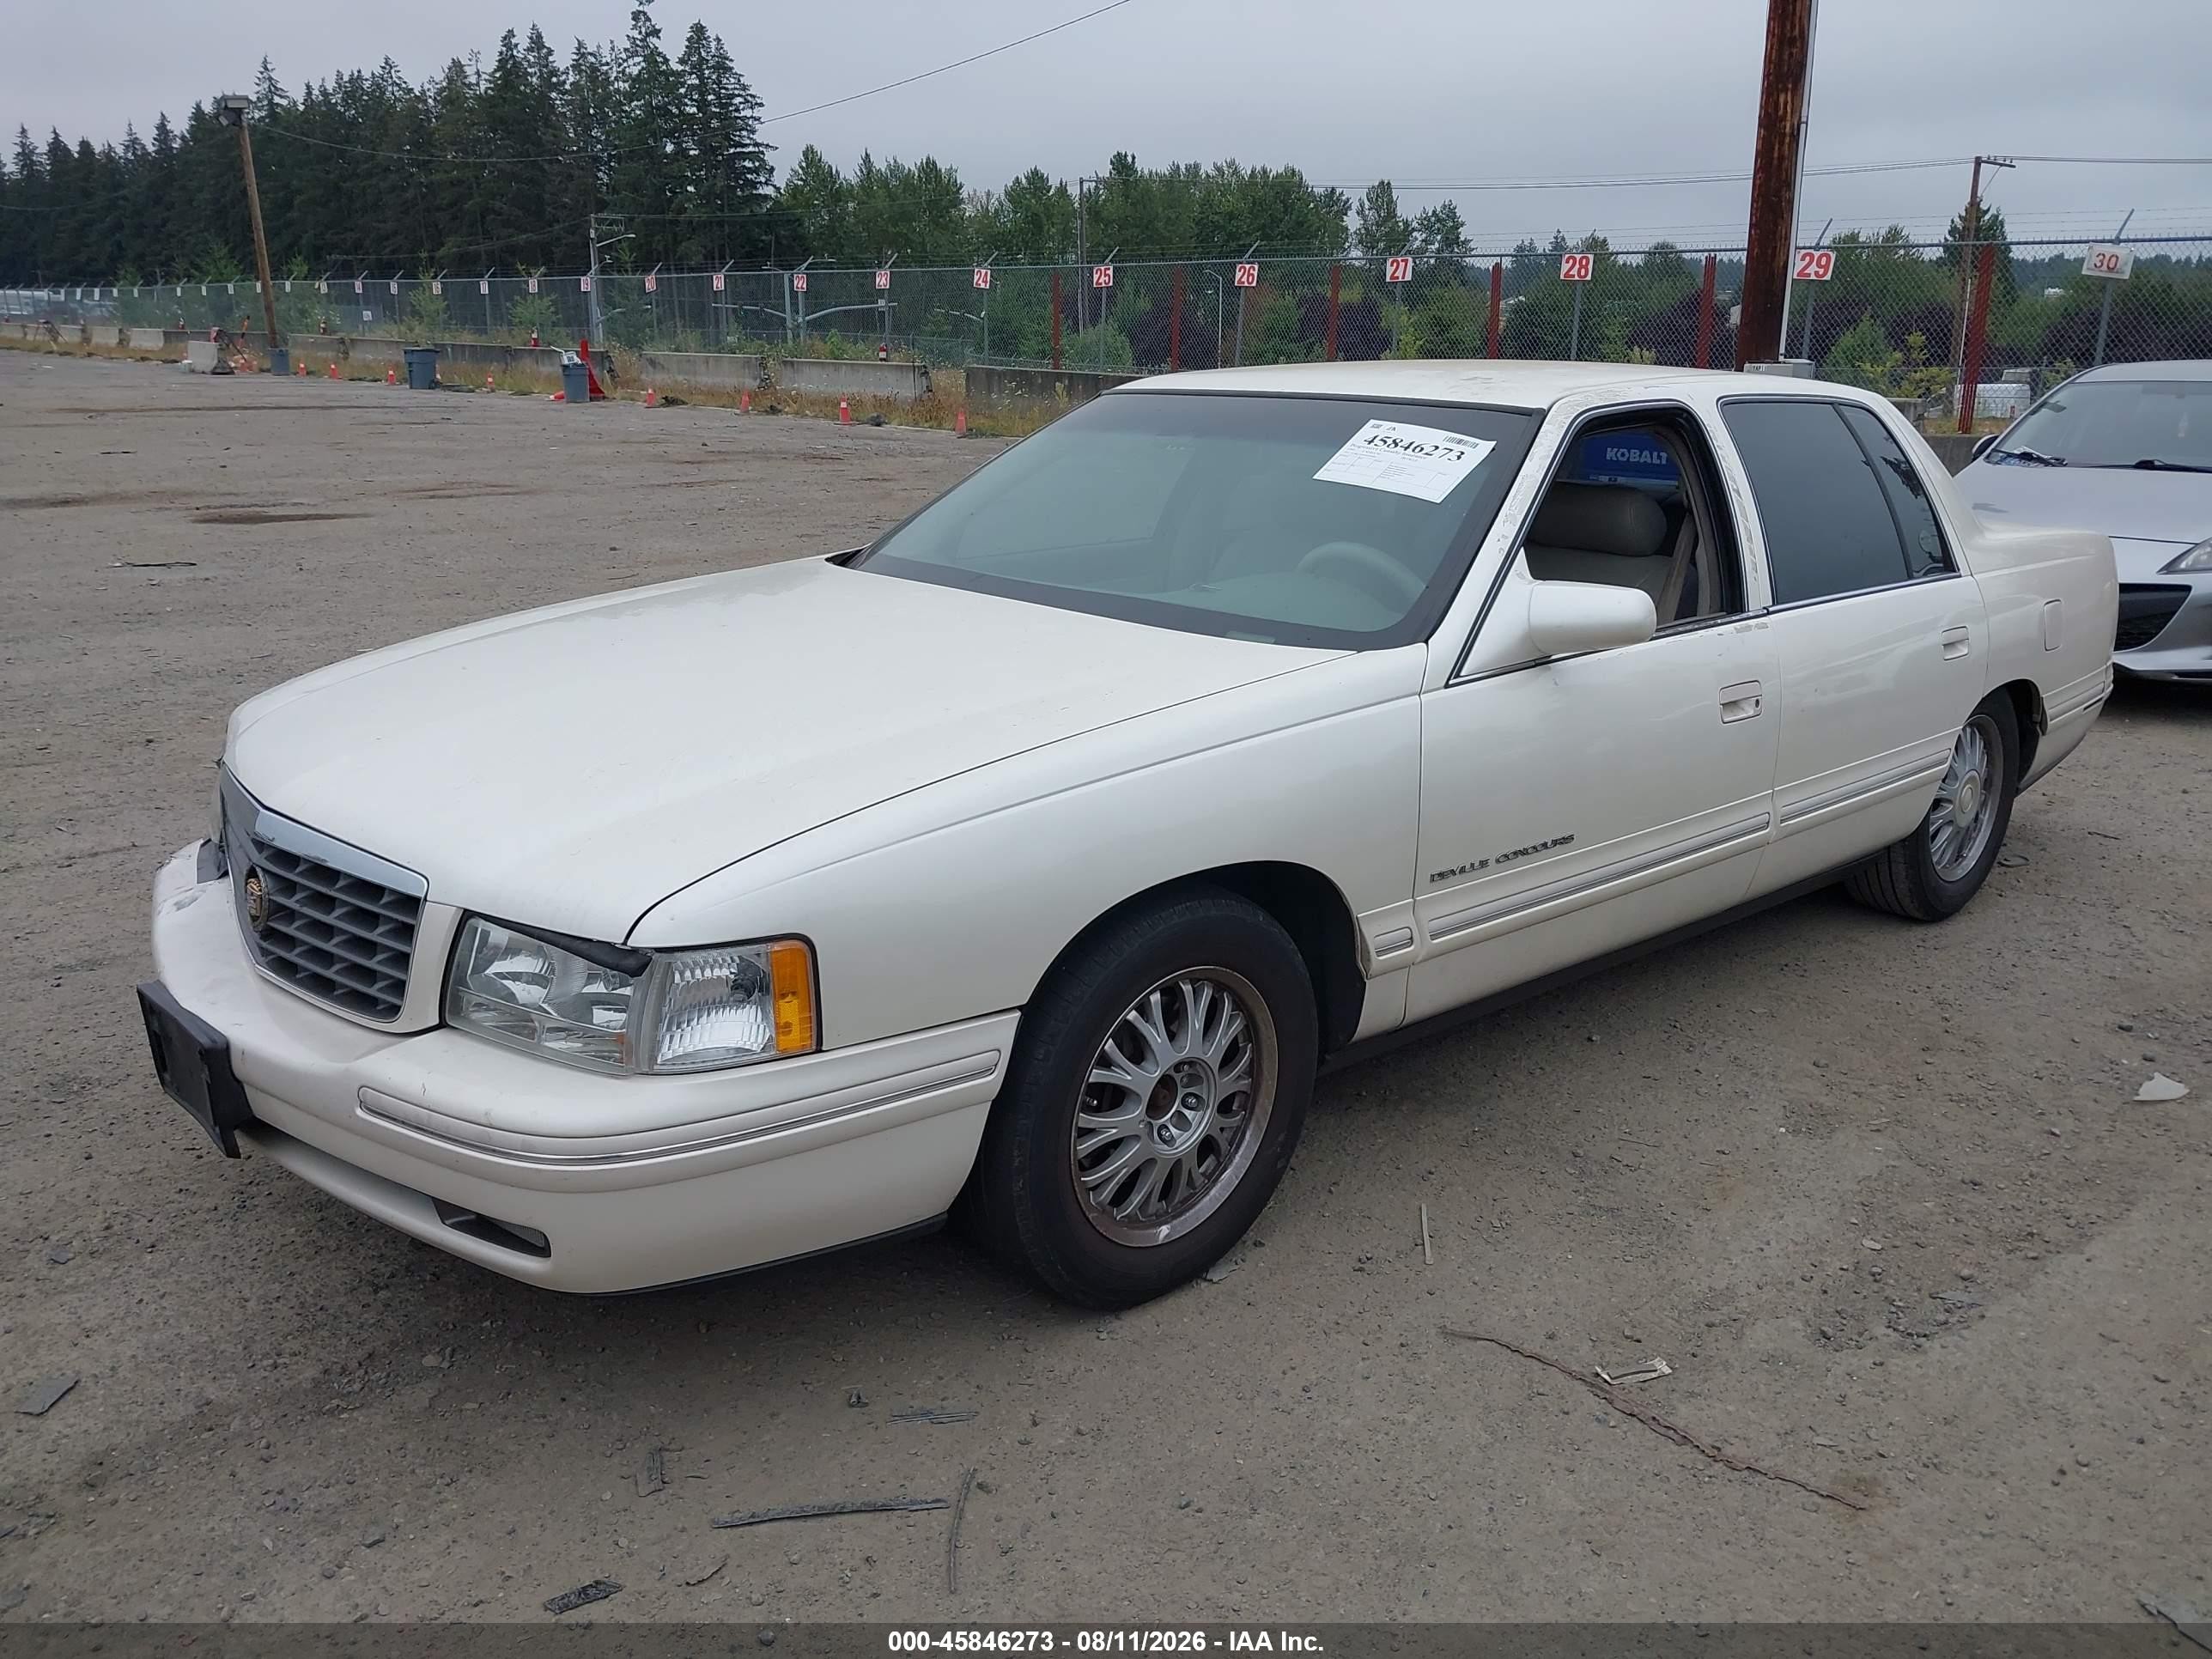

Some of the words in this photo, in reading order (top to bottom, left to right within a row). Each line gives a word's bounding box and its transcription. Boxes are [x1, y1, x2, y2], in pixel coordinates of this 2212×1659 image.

[1389, 258, 1409, 281] 27
[1564, 255, 1590, 279] 28
[1796, 252, 1832, 279] 29
[2094, 252, 2119, 270] 30
[582, 277, 589, 290] 19
[646, 277, 655, 290] 20
[715, 276, 723, 289] 21
[795, 275, 805, 290] 22
[877, 272, 889, 288] 23
[975, 270, 988, 287] 24
[1095, 267, 1111, 286] 25
[1237, 265, 1255, 285] 26
[1363, 434, 1466, 462] 45846273
[1606, 447, 1668, 465] KOBALT
[1429, 858, 1491, 883] DEVILLE
[1494, 834, 1576, 865] CONCOURS
